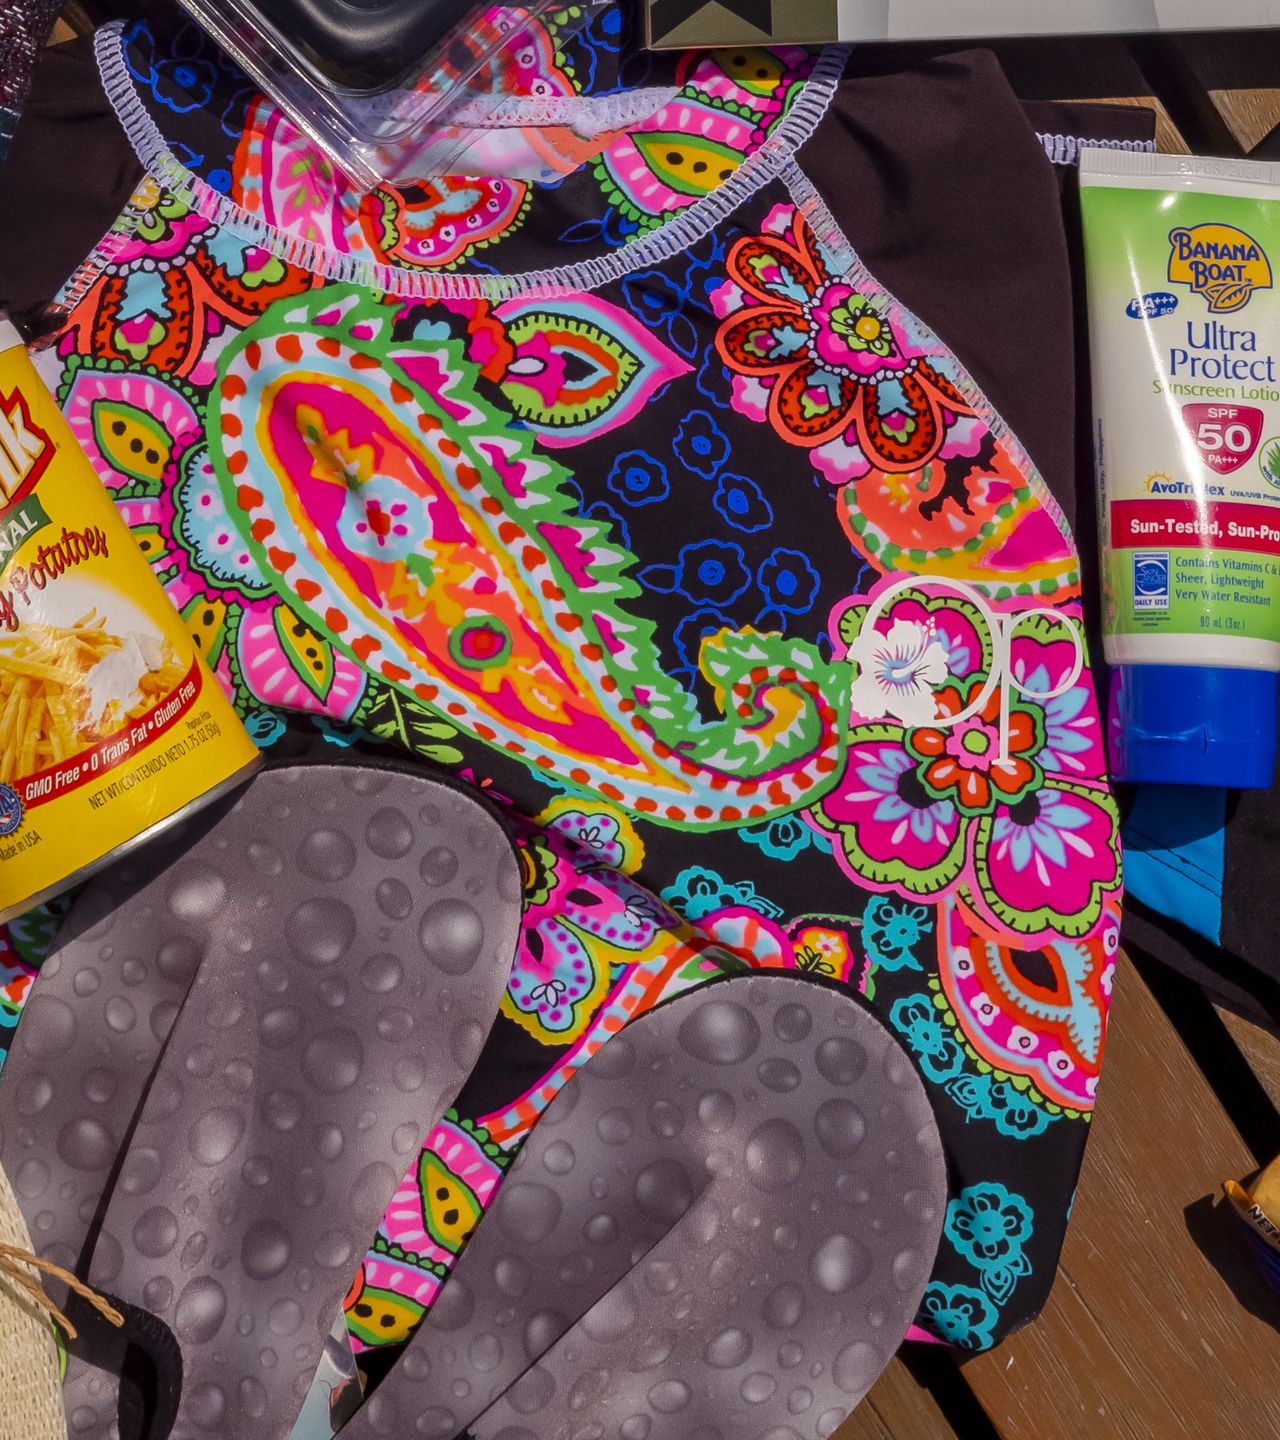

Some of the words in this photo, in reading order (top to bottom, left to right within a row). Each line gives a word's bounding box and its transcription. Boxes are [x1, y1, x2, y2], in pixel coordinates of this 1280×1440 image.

[1173, 232, 1261, 262] BANANA
[1188, 260, 1247, 289] BOAT
[1160, 307, 1175, 316] 50
[1186, 320, 1257, 352] Ultra
[1169, 348, 1277, 382] Protect
[1207, 407, 1238, 419] SPF
[1197, 423, 1252, 453] 50
[1208, 454, 1239, 465] PA+++
[1229, 489, 1262, 500] UVA/UVB
[1130, 518, 1224, 539] Sun-Tested,
[9, 525, 109, 606] Potatoes
[1175, 556, 1220, 569] Contains
[1222, 558, 1262, 573] Vitamins
[1264, 564, 1271, 574] C
[1271, 565, 1278, 575] &
[1175, 572, 1208, 585] Sheer,
[1210, 573, 1265, 591] Lightweight
[1134, 598, 1153, 606] DAILY
[1154, 598, 1168, 606] USE
[1175, 589, 1198, 602] Very
[1201, 590, 1231, 602] Water
[1233, 592, 1271, 607] Resistant
[1199, 616, 1210, 628] 90
[25, 776, 53, 801] GMO
[54, 766, 80, 791] Free
[100, 739, 130, 763] Trans
[130, 723, 149, 747] Fat
[154, 697, 182, 728] Gluten
[180, 680, 196, 704] Free
[87, 790, 109, 810] NET
[164, 742, 187, 764] NETO
[186, 735, 201, 752] 1.75
[195, 728, 210, 745] OZ
[17, 839, 26, 853] in
[24, 829, 42, 848] USA
[1247, 1203, 1278, 1237] NET
